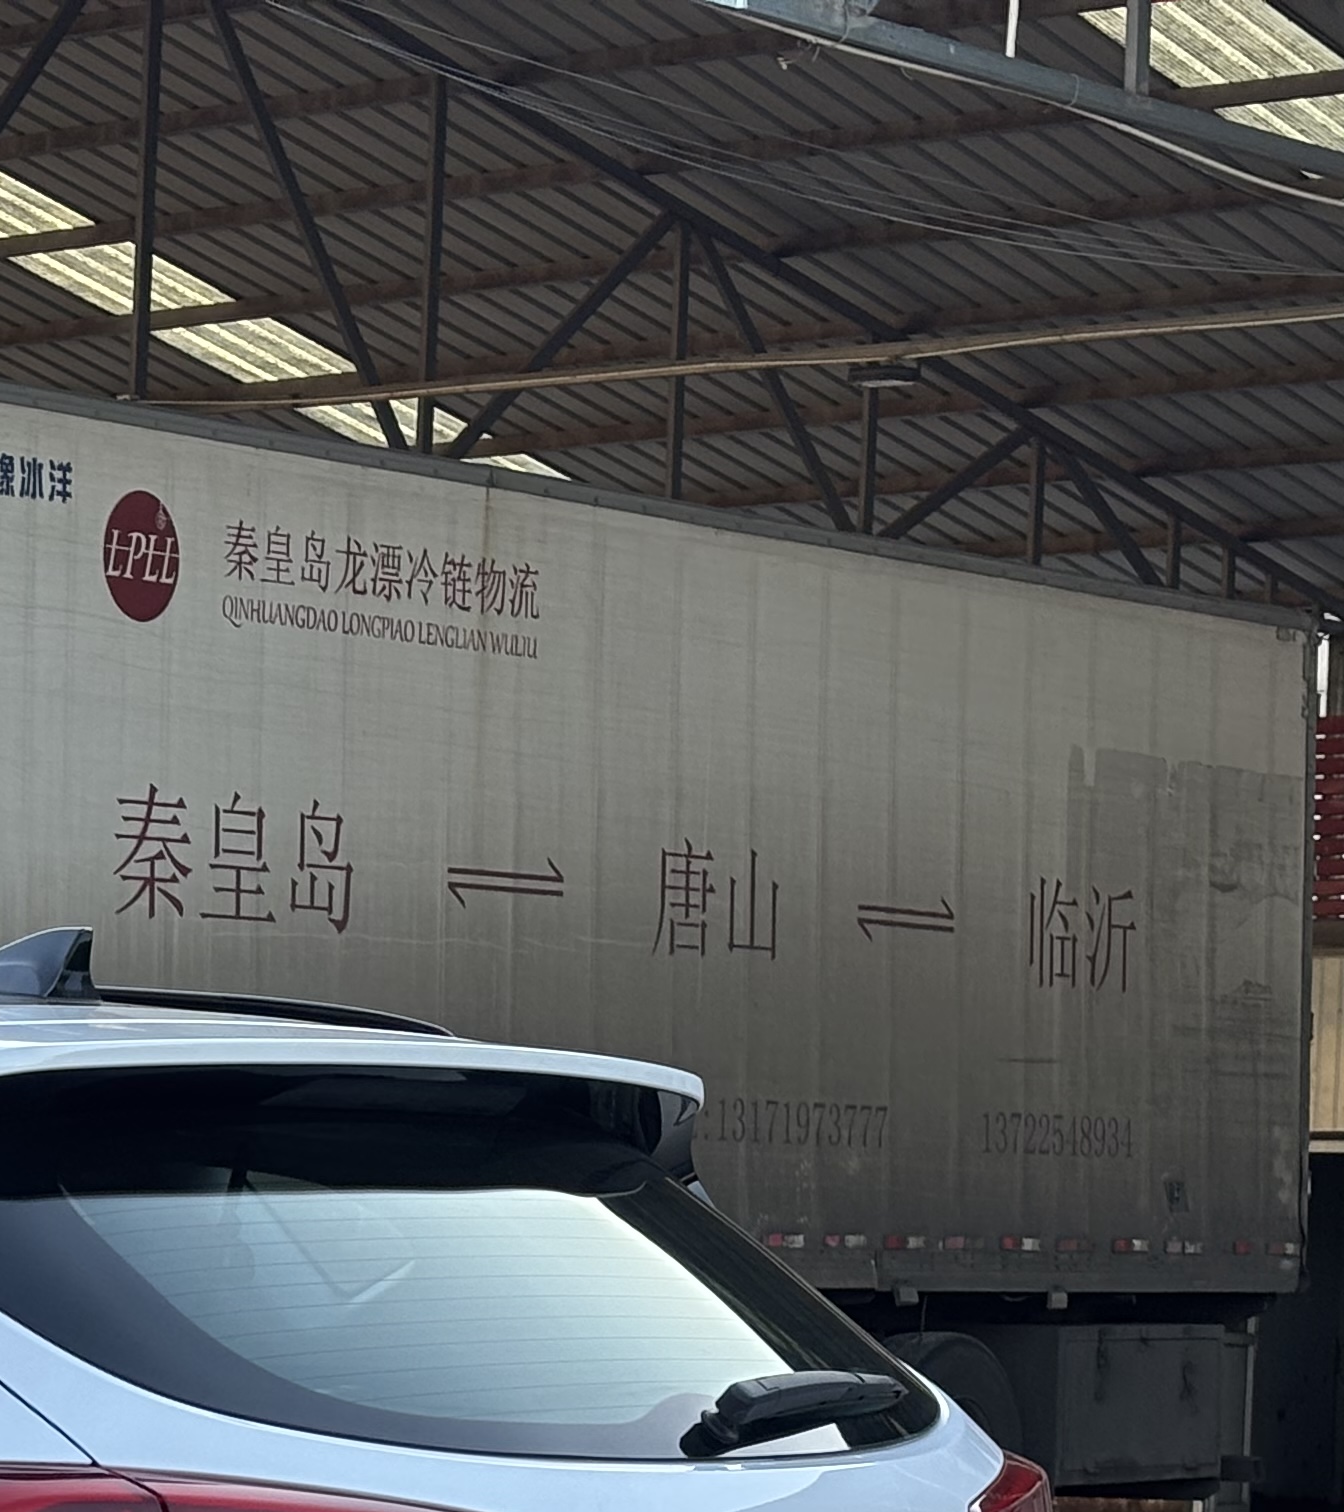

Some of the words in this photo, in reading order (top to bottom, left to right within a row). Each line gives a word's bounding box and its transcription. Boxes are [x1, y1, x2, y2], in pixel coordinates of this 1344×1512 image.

[223, 519, 540, 619] 秦皇岛龙漂冷链物流
[222, 595, 339, 628] QINHUANGDAO
[341, 610, 415, 643] LONGPIAO
[418, 622, 487, 653] LENGLIAN
[491, 630, 538, 659] WULIU
[113, 783, 354, 934] 秦皇岛
[652, 838, 780, 961] 唐山
[1029, 876, 1137, 993] 临沂
